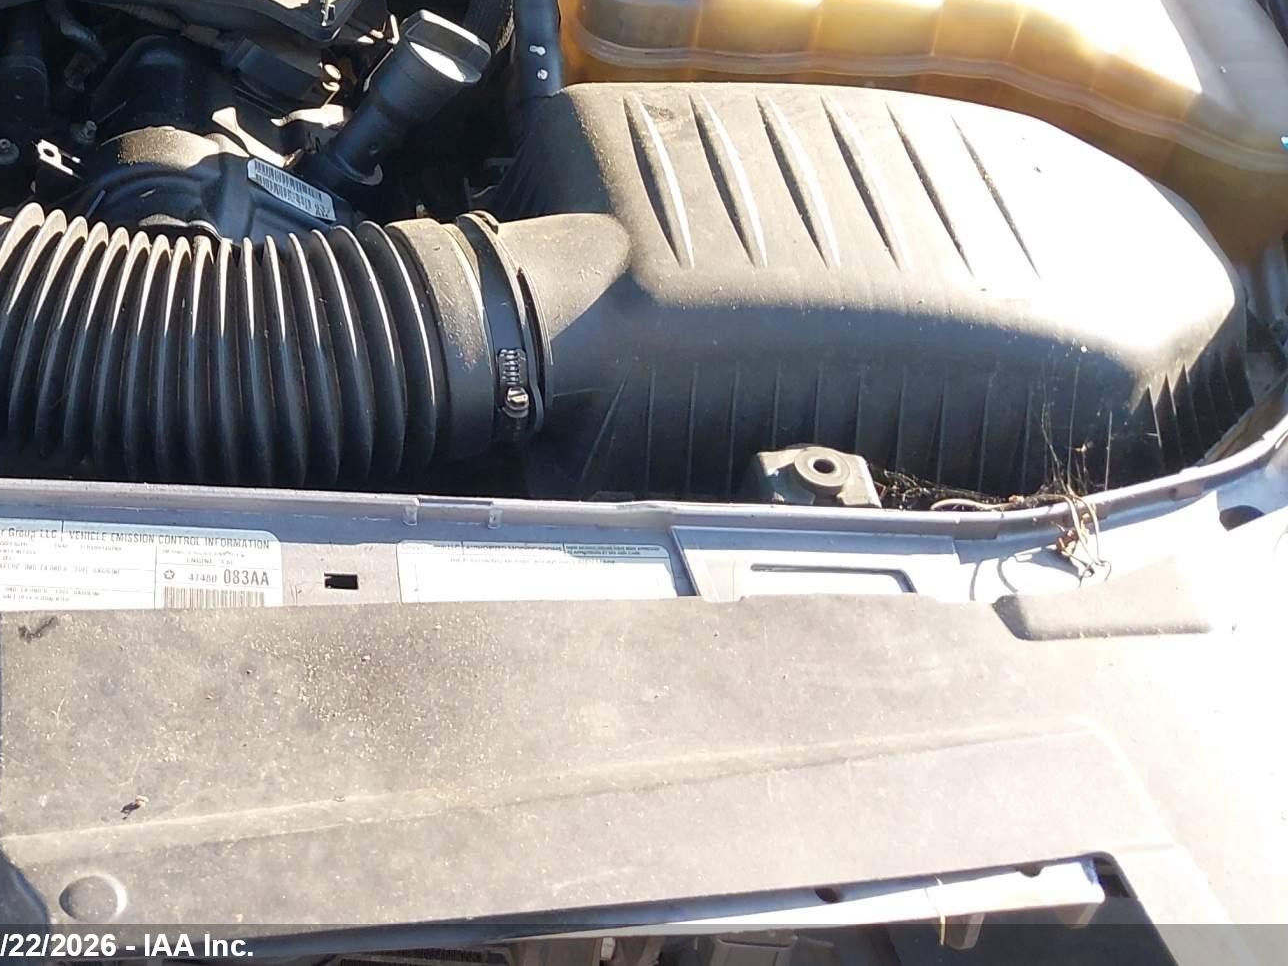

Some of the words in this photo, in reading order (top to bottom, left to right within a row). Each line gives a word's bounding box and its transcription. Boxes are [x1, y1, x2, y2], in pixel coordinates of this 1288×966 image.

[8, 527, 37, 540] Group
[40, 529, 57, 539] LLC
[68, 530, 106, 542] VEHICLE
[110, 532, 154, 544] EMISSION
[158, 534, 201, 547] CONTROL
[205, 537, 270, 550] INFORMATION
[223, 568, 270, 586] 083AA
